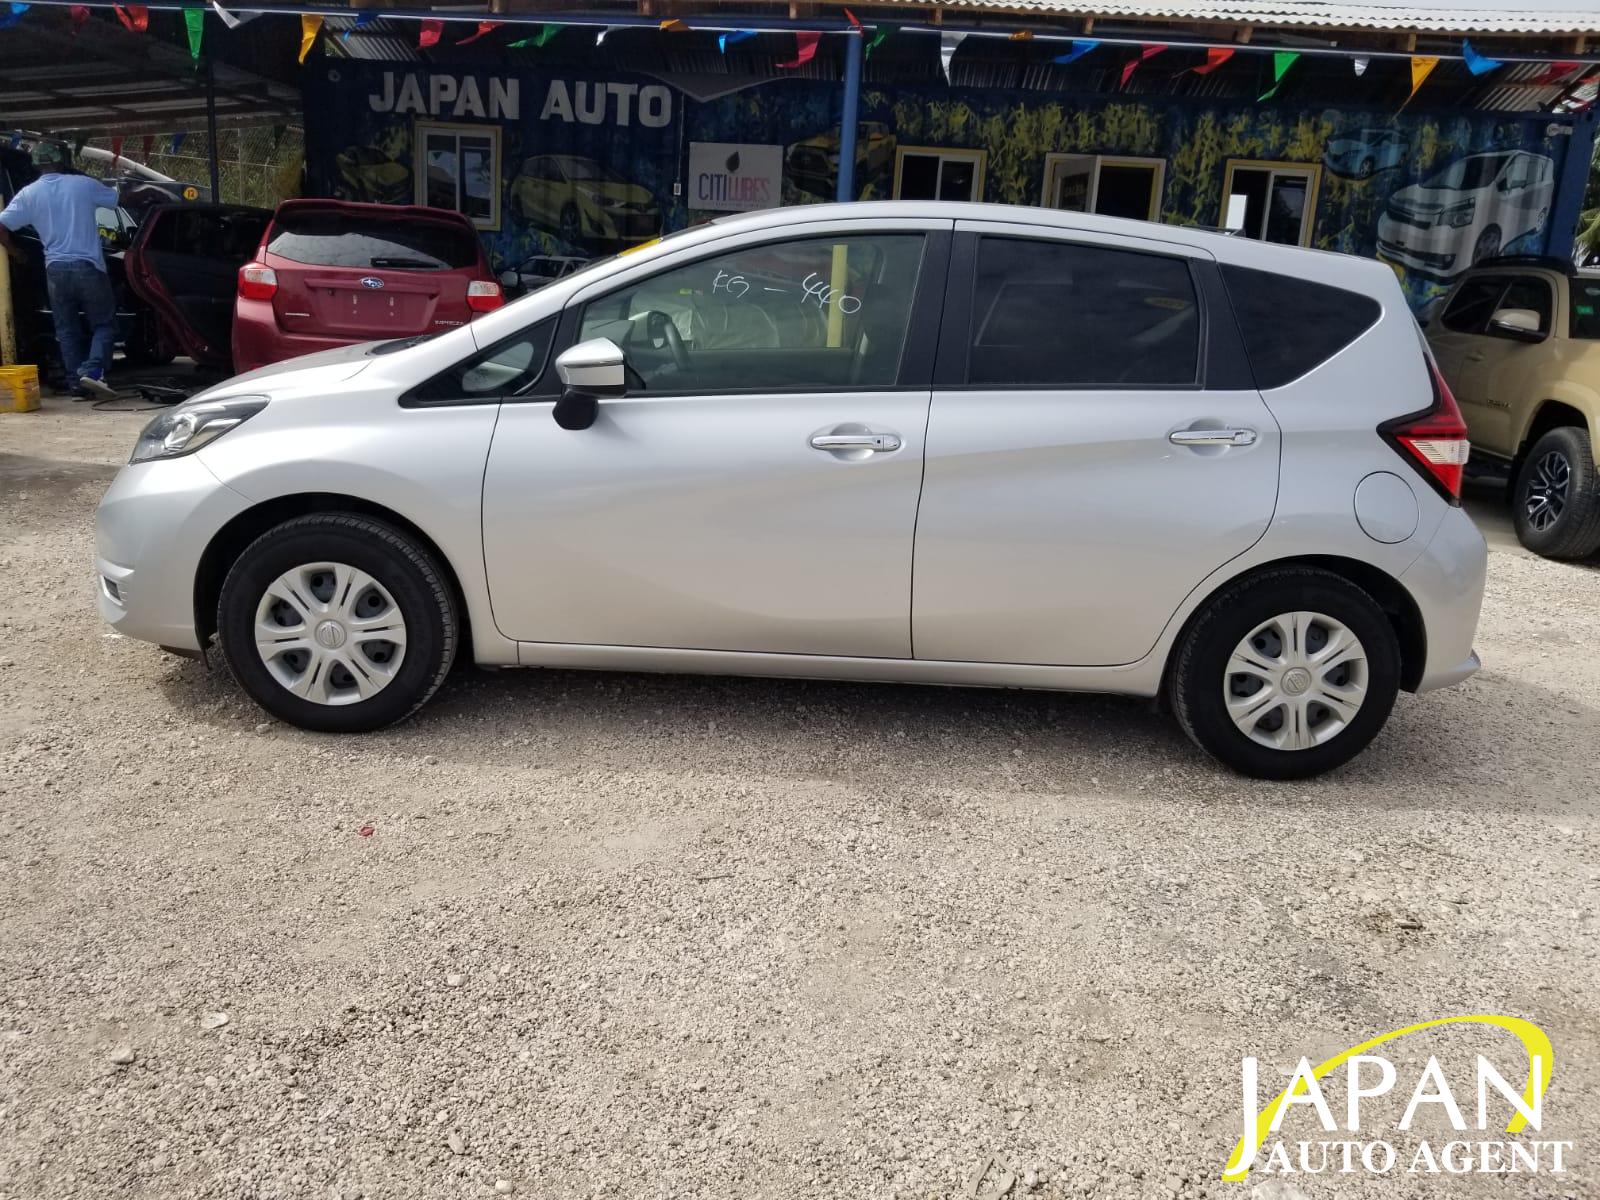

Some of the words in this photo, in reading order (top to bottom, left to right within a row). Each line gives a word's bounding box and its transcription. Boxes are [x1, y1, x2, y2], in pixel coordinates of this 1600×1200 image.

[369, 71, 520, 120] JAPAN
[540, 80, 673, 128] AUTO
[801, 272, 862, 313] 440
